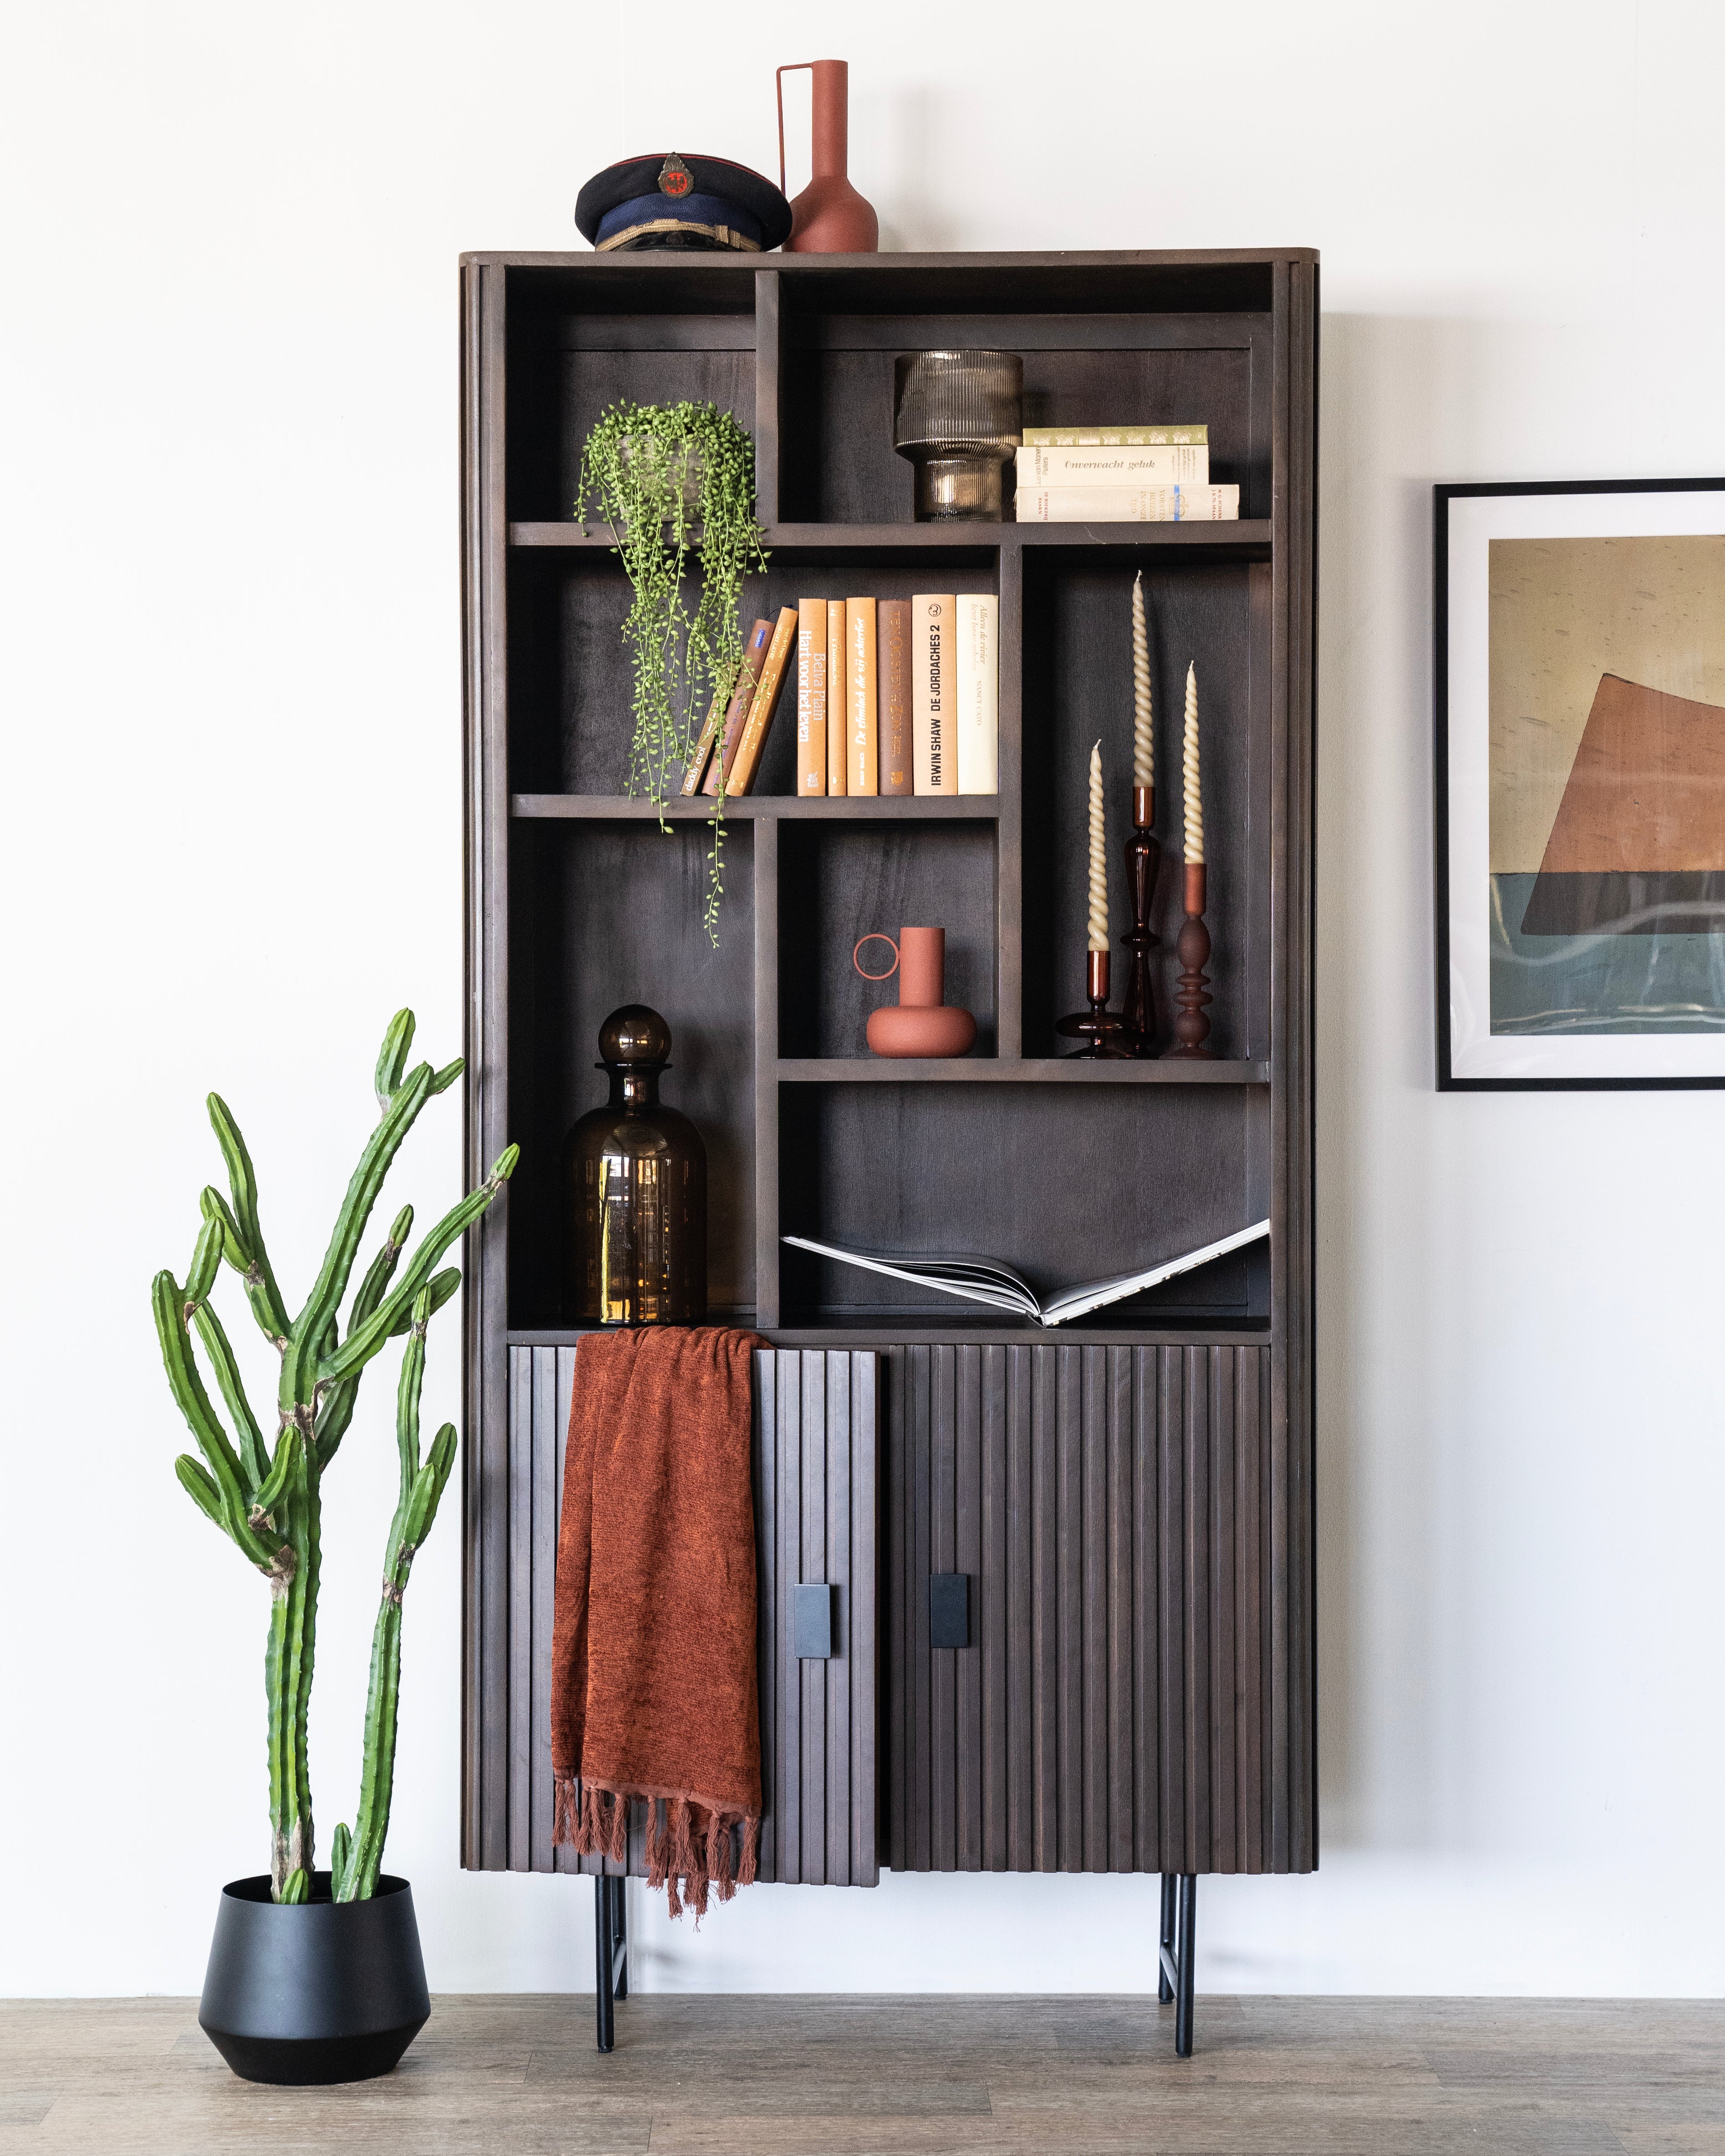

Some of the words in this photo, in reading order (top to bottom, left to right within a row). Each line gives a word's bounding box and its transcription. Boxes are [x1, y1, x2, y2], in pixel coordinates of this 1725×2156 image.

[1065, 460, 1124, 469] Onverwacht
[1127, 460, 1155, 470] geluk
[970, 603, 978, 620] kent
[979, 604, 988, 629] Alleen
[799, 630, 811, 660] Hart
[854, 617, 865, 658] achterliet
[970, 622, 978, 642] haar
[979, 631, 988, 641] de
[856, 659, 868, 673] zij
[930, 634, 941, 696] JORDACHES
[979, 642, 988, 665] rivier
[799, 660, 809, 689] voor
[813, 653, 825, 687] Belva
[855, 675, 866, 689] die
[799, 689, 811, 711] het
[813, 690, 825, 721] Plain
[855, 691, 868, 730] glimlach
[930, 698, 941, 711] DE
[799, 711, 811, 743] leven
[890, 705, 903, 731] ZON
[855, 731, 866, 746] De
[931, 719, 942, 751] SHAW
[685, 765, 701, 791] daddy
[696, 746, 706, 765] cool
[931, 753, 942, 786] IRWIN
